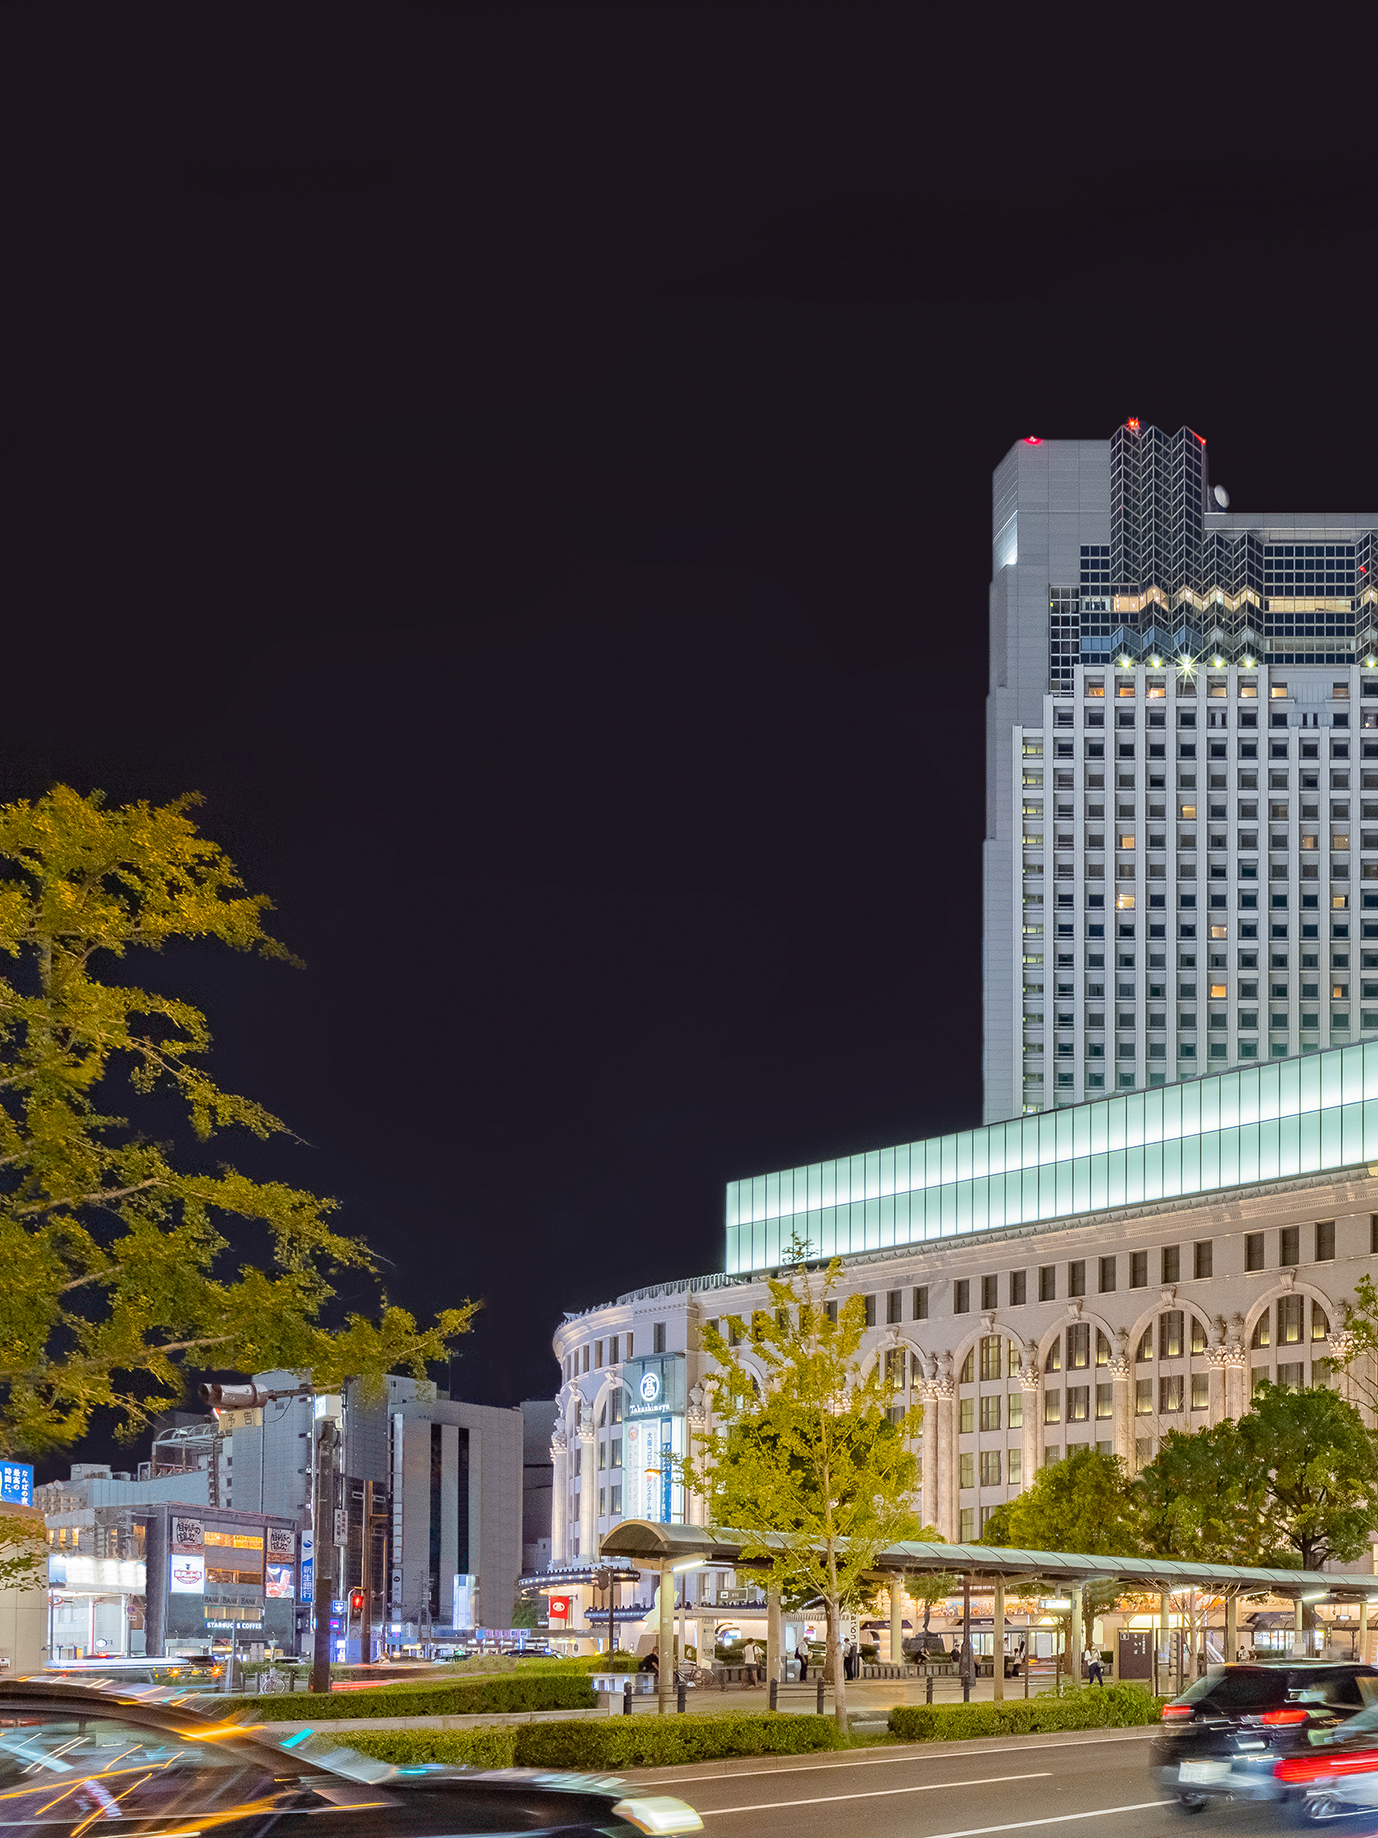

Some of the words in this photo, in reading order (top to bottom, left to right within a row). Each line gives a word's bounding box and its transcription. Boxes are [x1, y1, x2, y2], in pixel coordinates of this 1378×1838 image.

[630, 1403, 670, 1414] Takashimaya
[303, 1565, 312, 1599] 新生銀行
[205, 1595, 220, 1604] BANK
[222, 1596, 238, 1604] BANK
[241, 1597, 256, 1605] BANK
[241, 1622, 263, 1630] COFFEE
